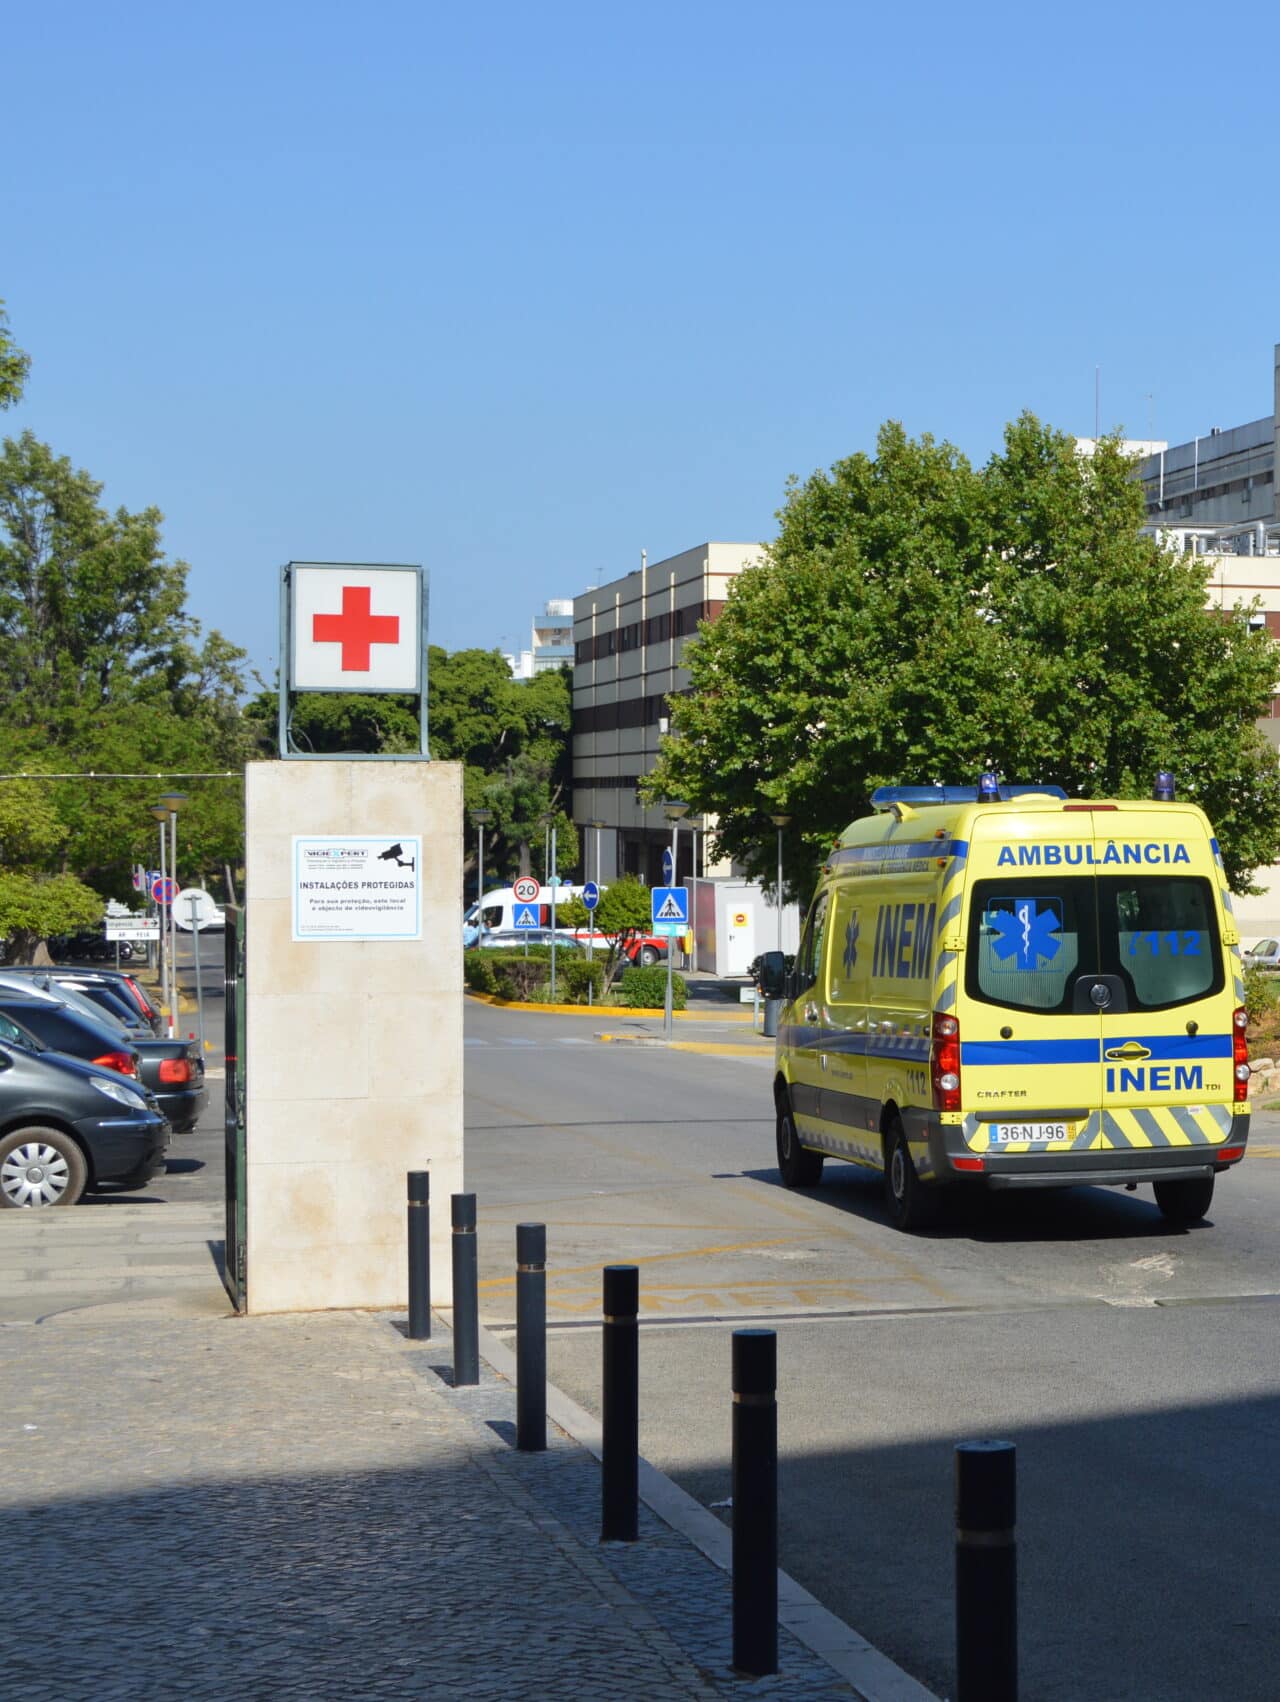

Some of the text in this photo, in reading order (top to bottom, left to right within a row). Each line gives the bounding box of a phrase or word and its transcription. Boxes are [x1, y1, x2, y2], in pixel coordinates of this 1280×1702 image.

[997, 840, 1191, 866] AMBULÂNCIA
[299, 880, 415, 890] INSTALAÇÕES PROTEGIDAS
[518, 885, 535, 896] 20
[872, 903, 936, 979] INEM
[1144, 930, 1202, 956] 112
[1106, 1065, 1221, 1093] INEM TDI
[976, 1090, 1027, 1098] CRAFTER
